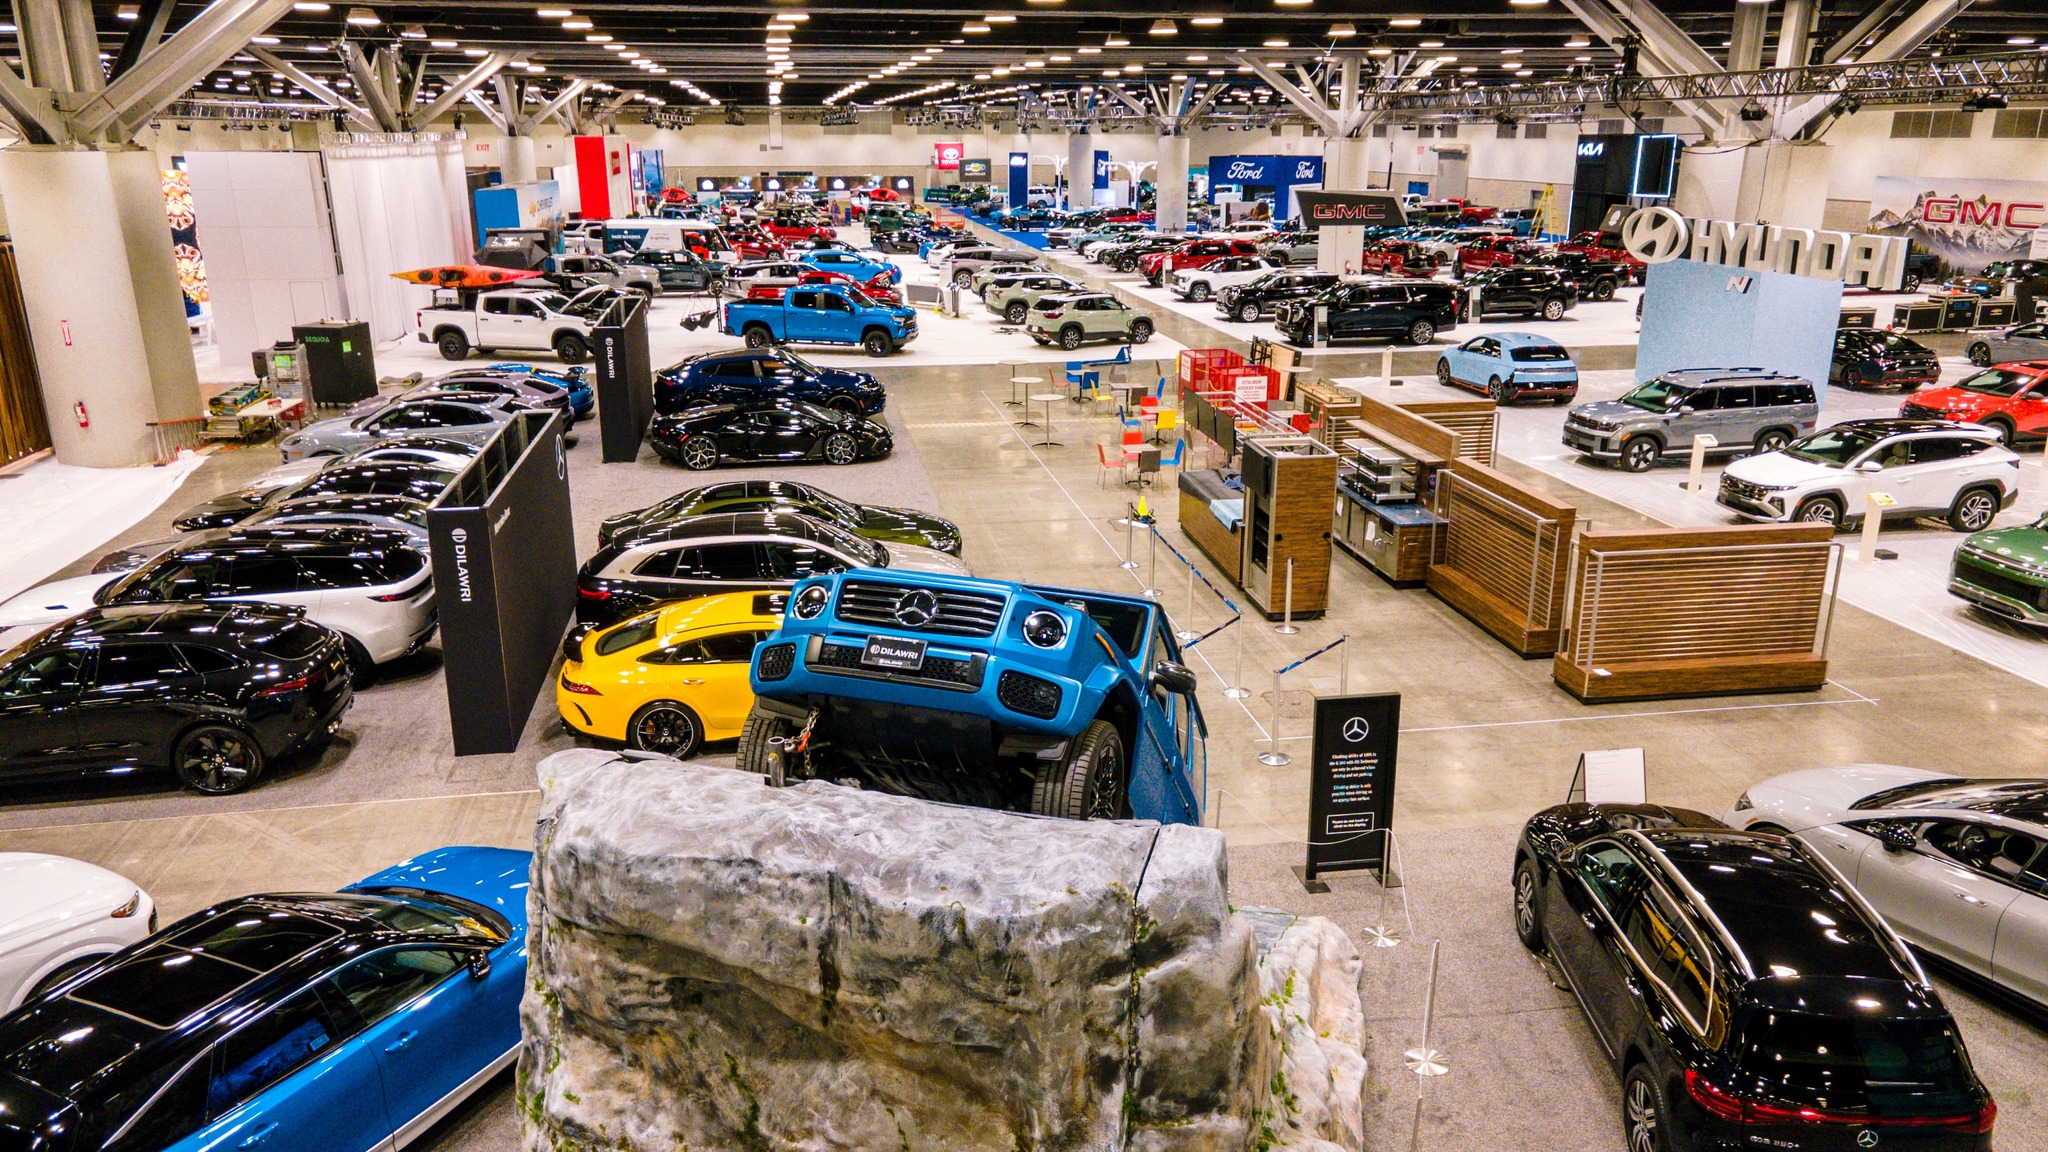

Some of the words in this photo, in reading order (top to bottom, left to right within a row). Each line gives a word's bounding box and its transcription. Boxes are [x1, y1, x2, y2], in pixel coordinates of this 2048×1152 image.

[1578, 142, 1604, 156] KIA
[1227, 161, 1264, 179] Ford
[1296, 161, 1315, 179] Ford
[1314, 204, 1386, 219] GMC
[1922, 198, 2046, 230] GMC
[1690, 218, 1908, 291] HYUNDAI
[606, 346, 615, 378] DILAWRI
[455, 544, 472, 601] DILAWRI
[880, 647, 918, 659] DILAWRI
